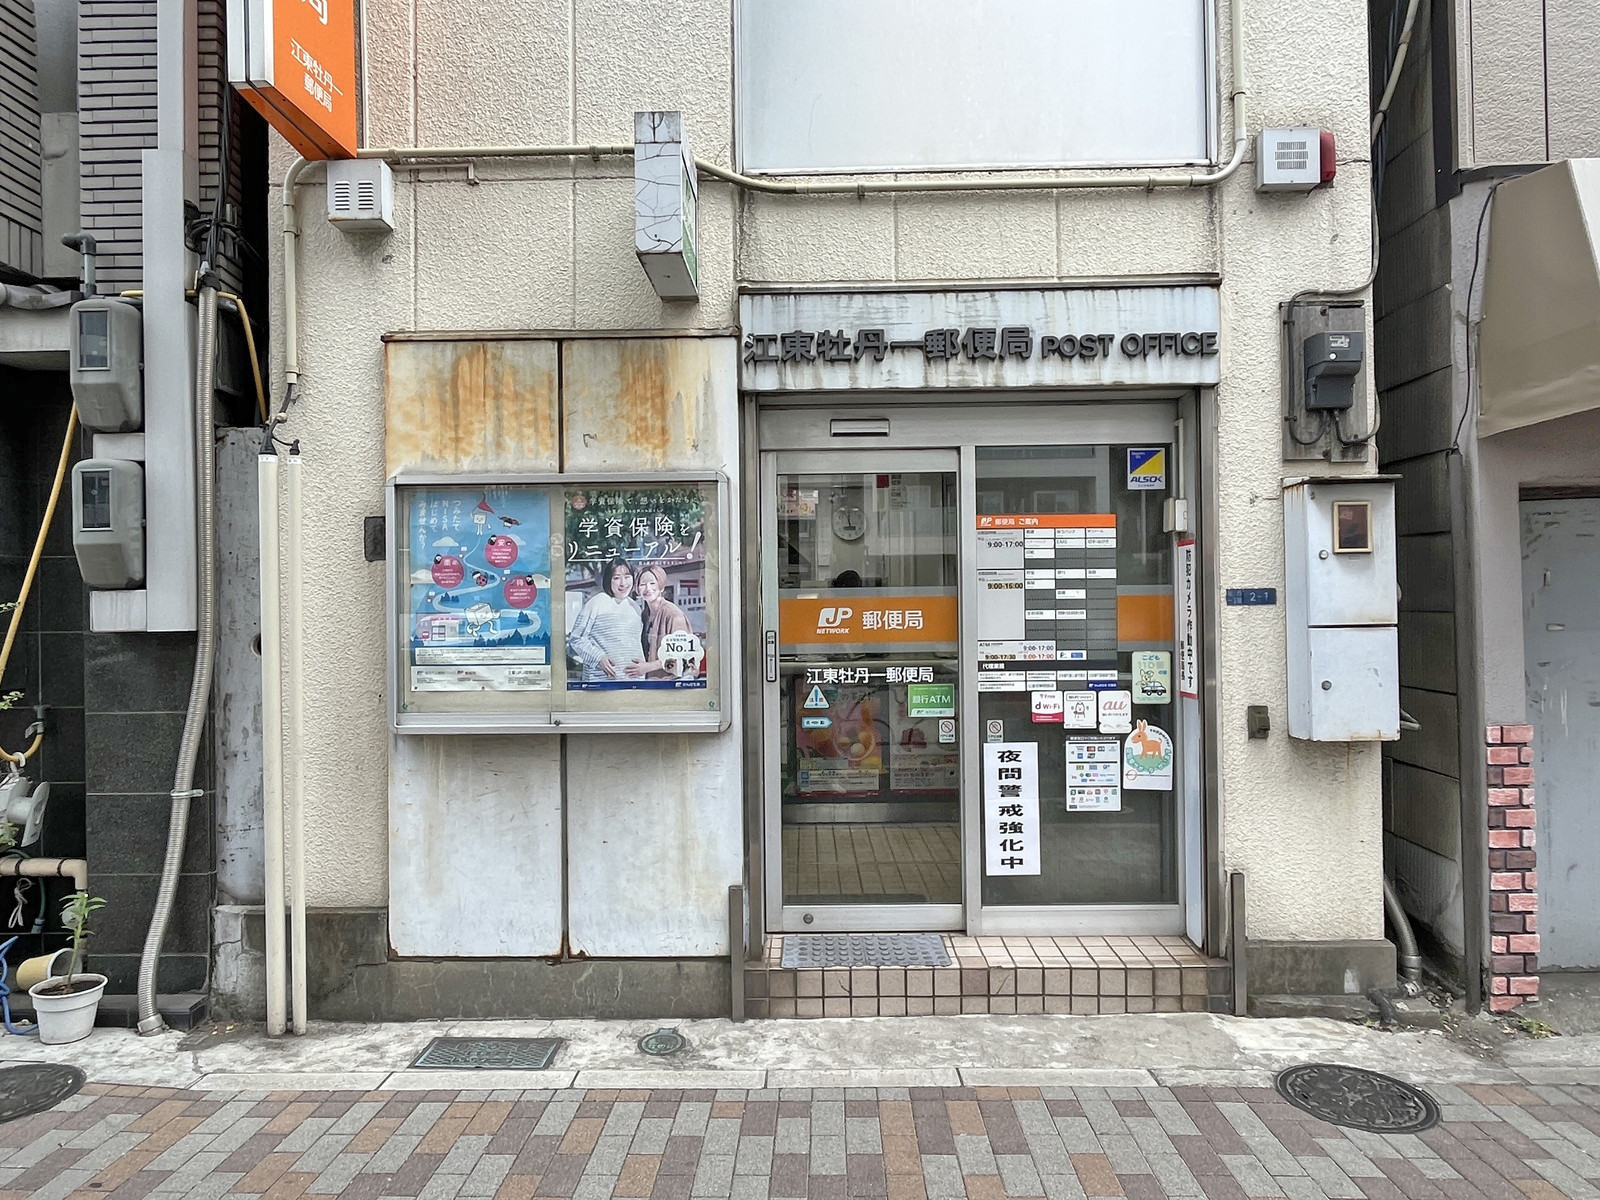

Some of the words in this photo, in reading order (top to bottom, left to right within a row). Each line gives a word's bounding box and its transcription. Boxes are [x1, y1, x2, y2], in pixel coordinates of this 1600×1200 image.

[290, 37, 344, 96] 江東牡丹一
[304, 71, 333, 113] 郵便局
[744, 326, 1034, 364] 江東牡丹一郵便局
[1041, 334, 1115, 359] POST
[1120, 331, 1219, 359] OFFICE
[452, 500, 461, 532] つみたて
[579, 516, 690, 538] 学資保険を
[1249, 592, 1269, 602] 2-1
[862, 610, 924, 630] 郵便局
[665, 639, 696, 653] No.1
[806, 666, 934, 684] 江東牡丹一郵便局
[912, 694, 951, 704] 銀行ATM
[1102, 700, 1128, 711] au
[997, 750, 1024, 869] 夜間警戒強化中
